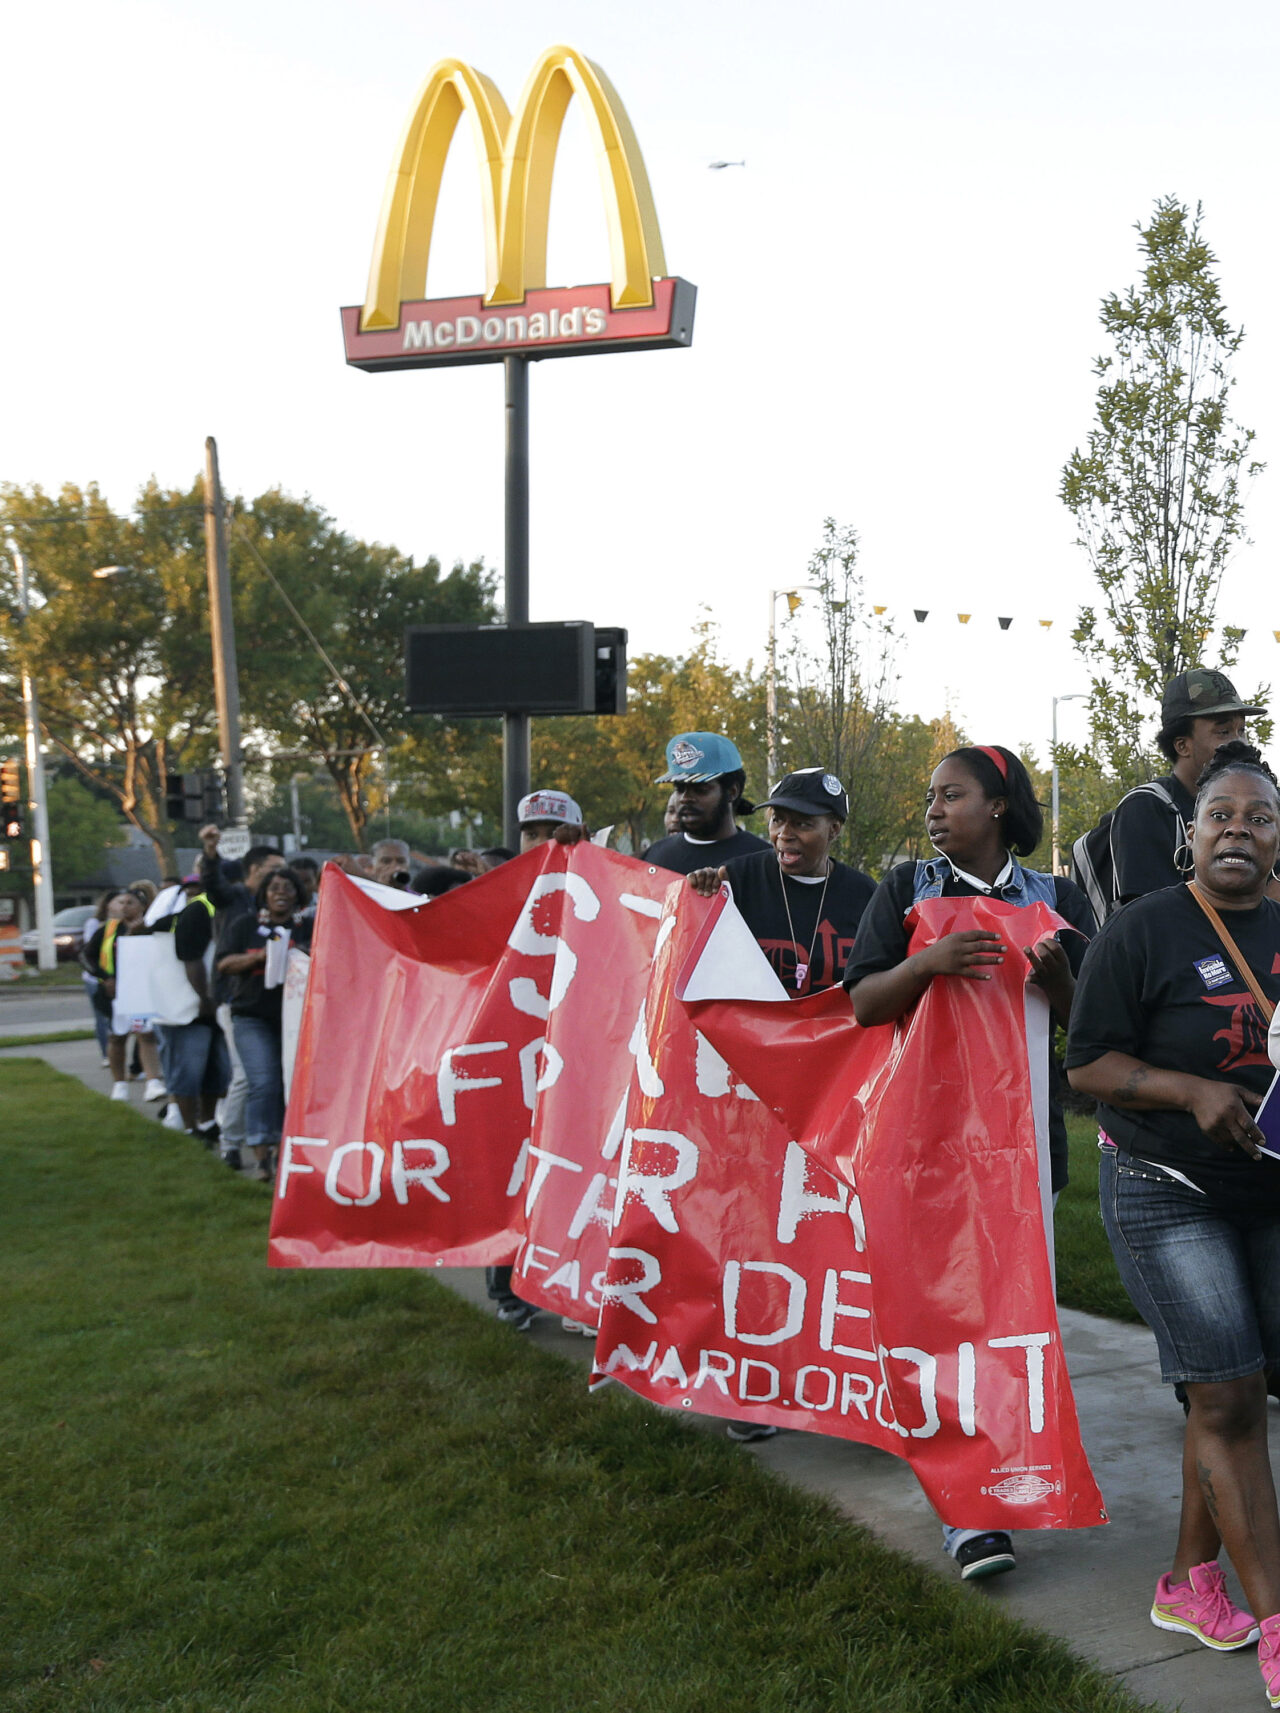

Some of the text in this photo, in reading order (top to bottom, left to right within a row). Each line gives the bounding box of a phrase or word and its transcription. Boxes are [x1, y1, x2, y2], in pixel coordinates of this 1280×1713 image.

[402, 306, 607, 350] McDonald's
[279, 1136, 450, 1206] FOR
[1028, 1464, 1052, 1472] SERVICES
